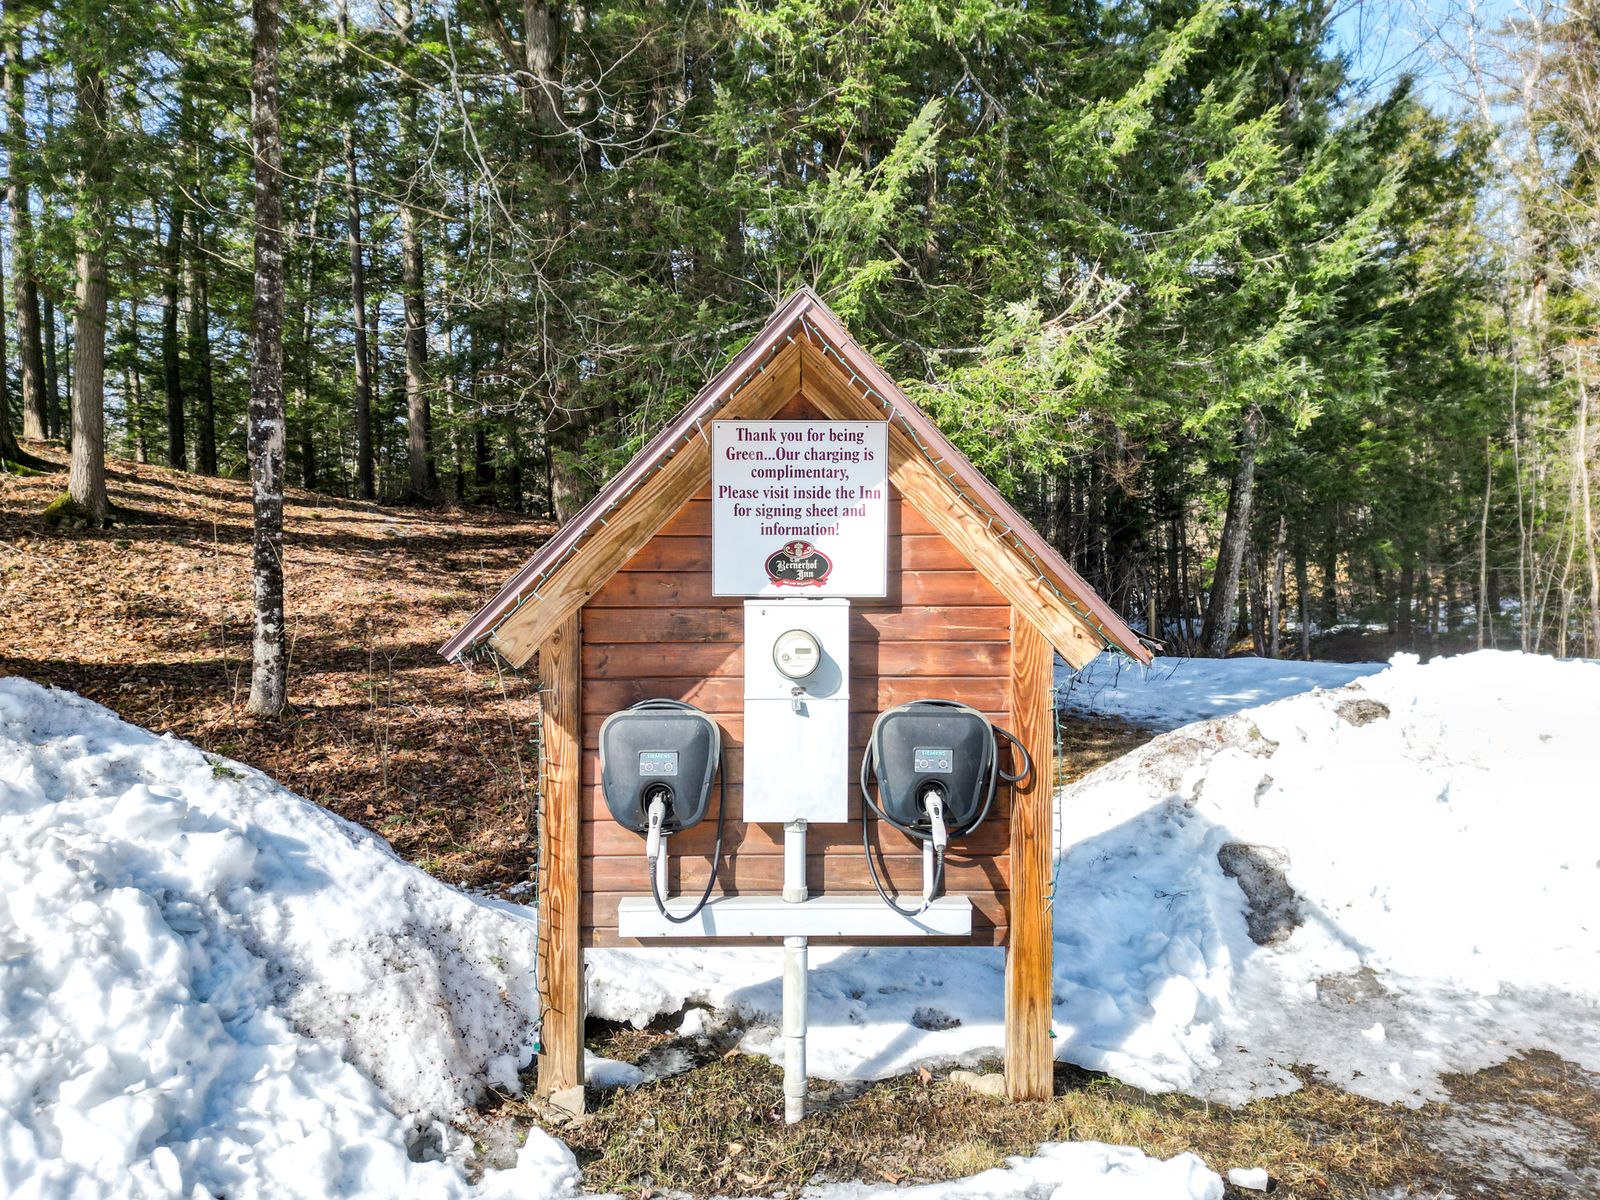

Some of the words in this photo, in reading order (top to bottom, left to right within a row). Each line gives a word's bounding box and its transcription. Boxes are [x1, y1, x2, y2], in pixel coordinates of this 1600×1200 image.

[736, 427, 777, 442] Thank
[780, 430, 803, 444] you
[807, 427, 826, 442] for
[829, 427, 865, 444] being
[725, 446, 801, 461] Green...Our
[804, 447, 860, 463] charging
[863, 447, 875, 461] is
[751, 465, 850, 481] complimentary,
[718, 485, 759, 499] Please
[763, 485, 789, 499] visit
[793, 485, 832, 499] inside
[835, 485, 855, 499] the
[859, 485, 881, 499] Inn
[733, 503, 752, 517] for
[755, 503, 802, 519] signing
[805, 503, 838, 517] sheet
[842, 503, 866, 517] and
[760, 522, 840, 536] information!
[796, 569, 814, 580] Inn
